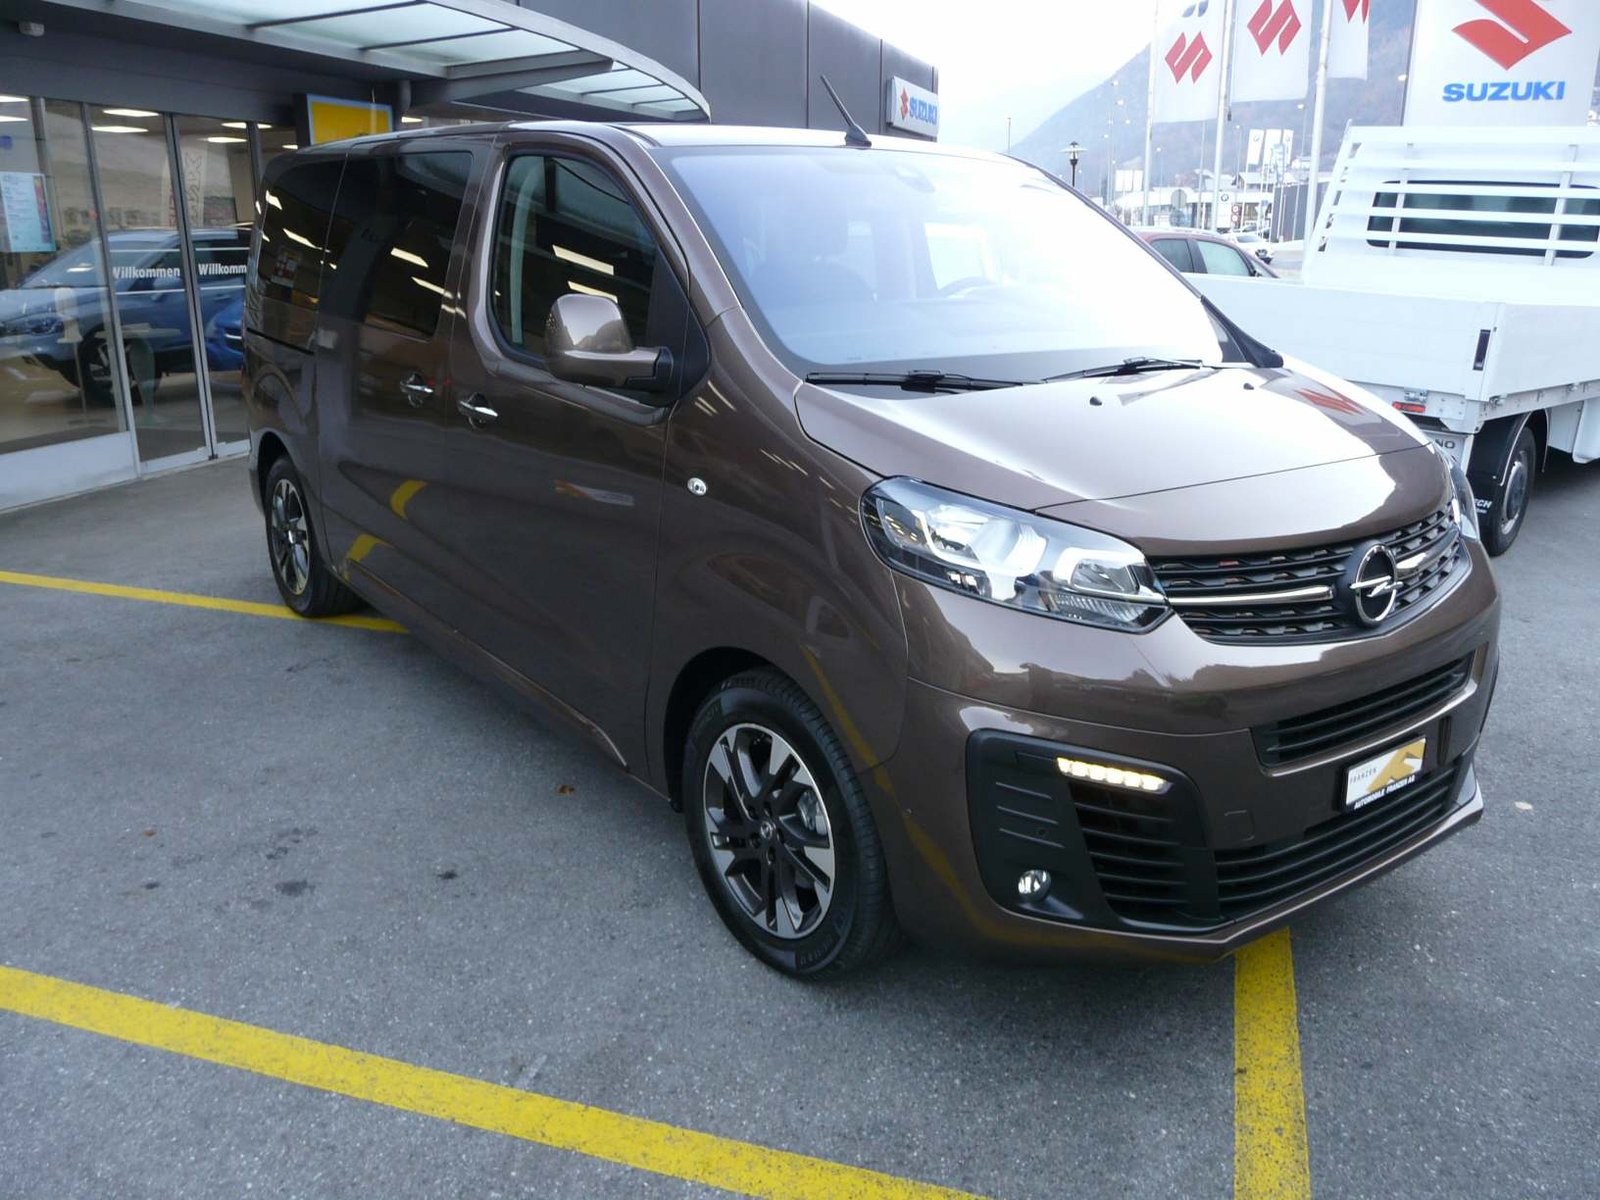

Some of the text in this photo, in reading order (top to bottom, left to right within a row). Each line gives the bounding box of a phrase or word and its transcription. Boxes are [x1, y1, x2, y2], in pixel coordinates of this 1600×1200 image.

[1442, 81, 1566, 102] SUZUKI
[910, 96, 938, 125] SUZUKI
[198, 263, 247, 275] Willkomm
